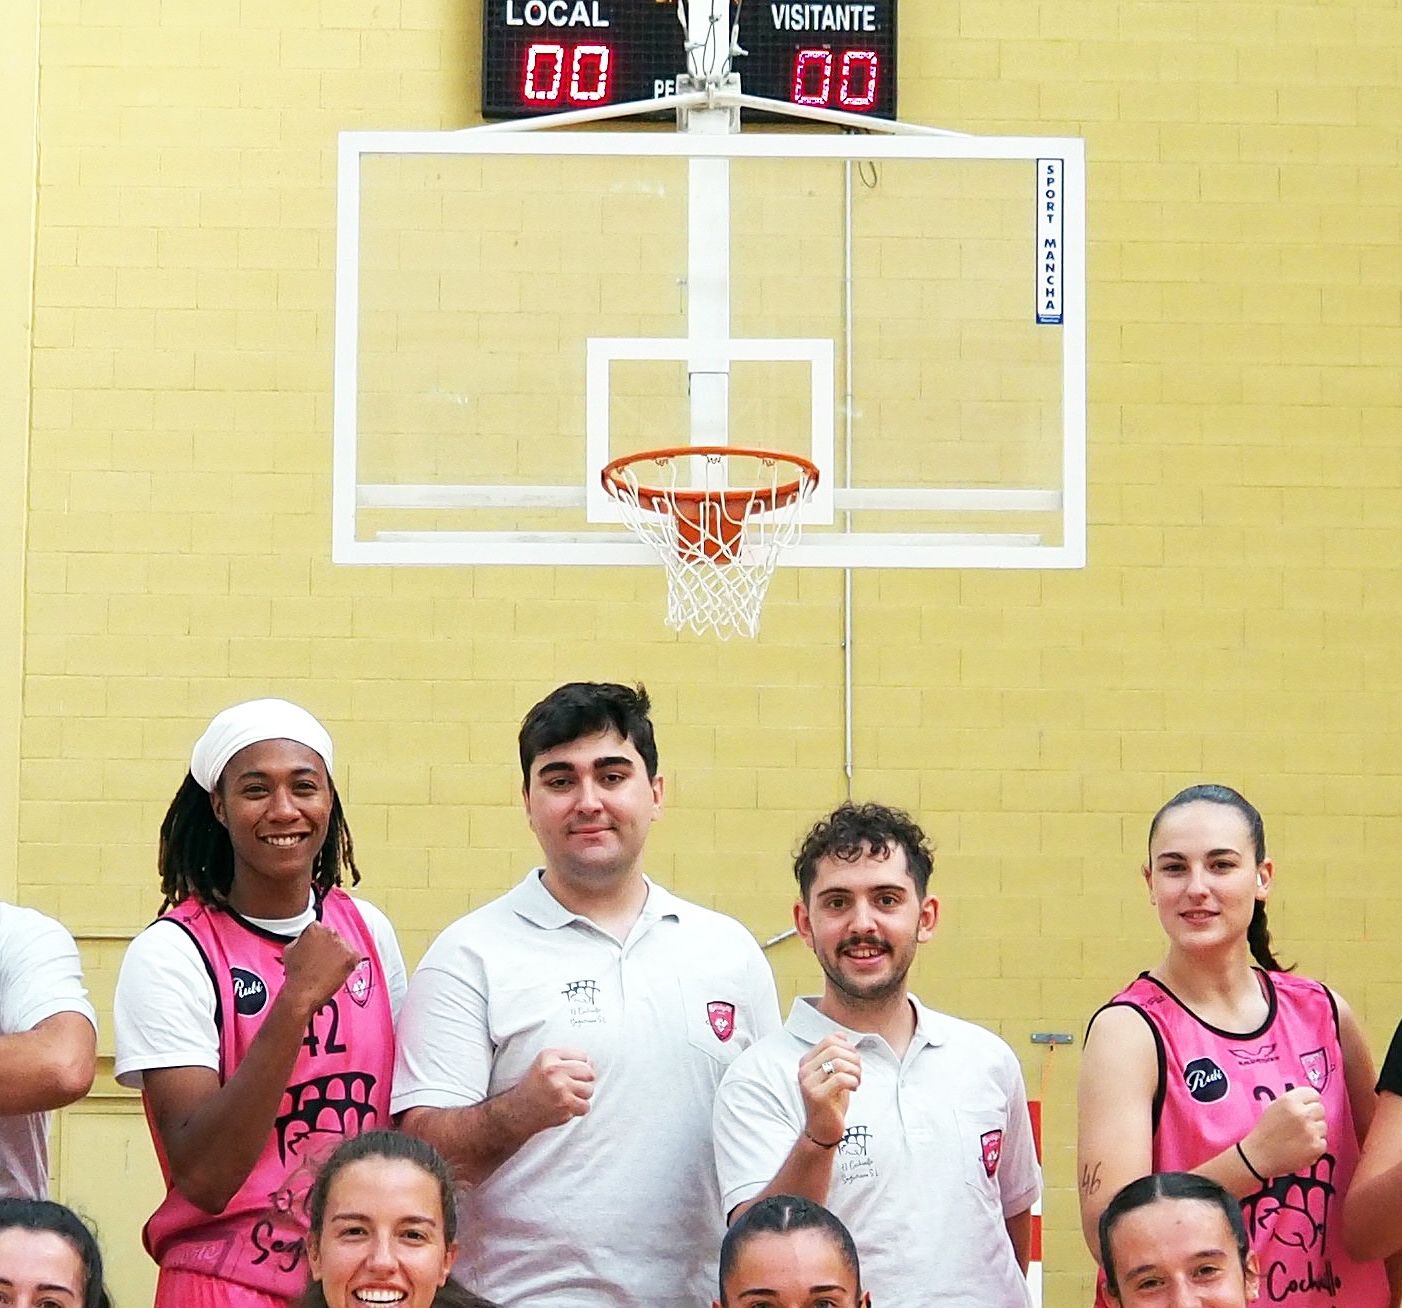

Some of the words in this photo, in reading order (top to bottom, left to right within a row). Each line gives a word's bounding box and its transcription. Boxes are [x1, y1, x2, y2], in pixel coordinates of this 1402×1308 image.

[506, 0, 610, 27] LOCAL
[772, 4, 877, 31] VISITANTE
[524, 44, 610, 100] 00
[1045, 165, 1056, 223] SPORT
[1044, 238, 1057, 310] MANCHA
[1081, 1160, 1102, 1199] 46
